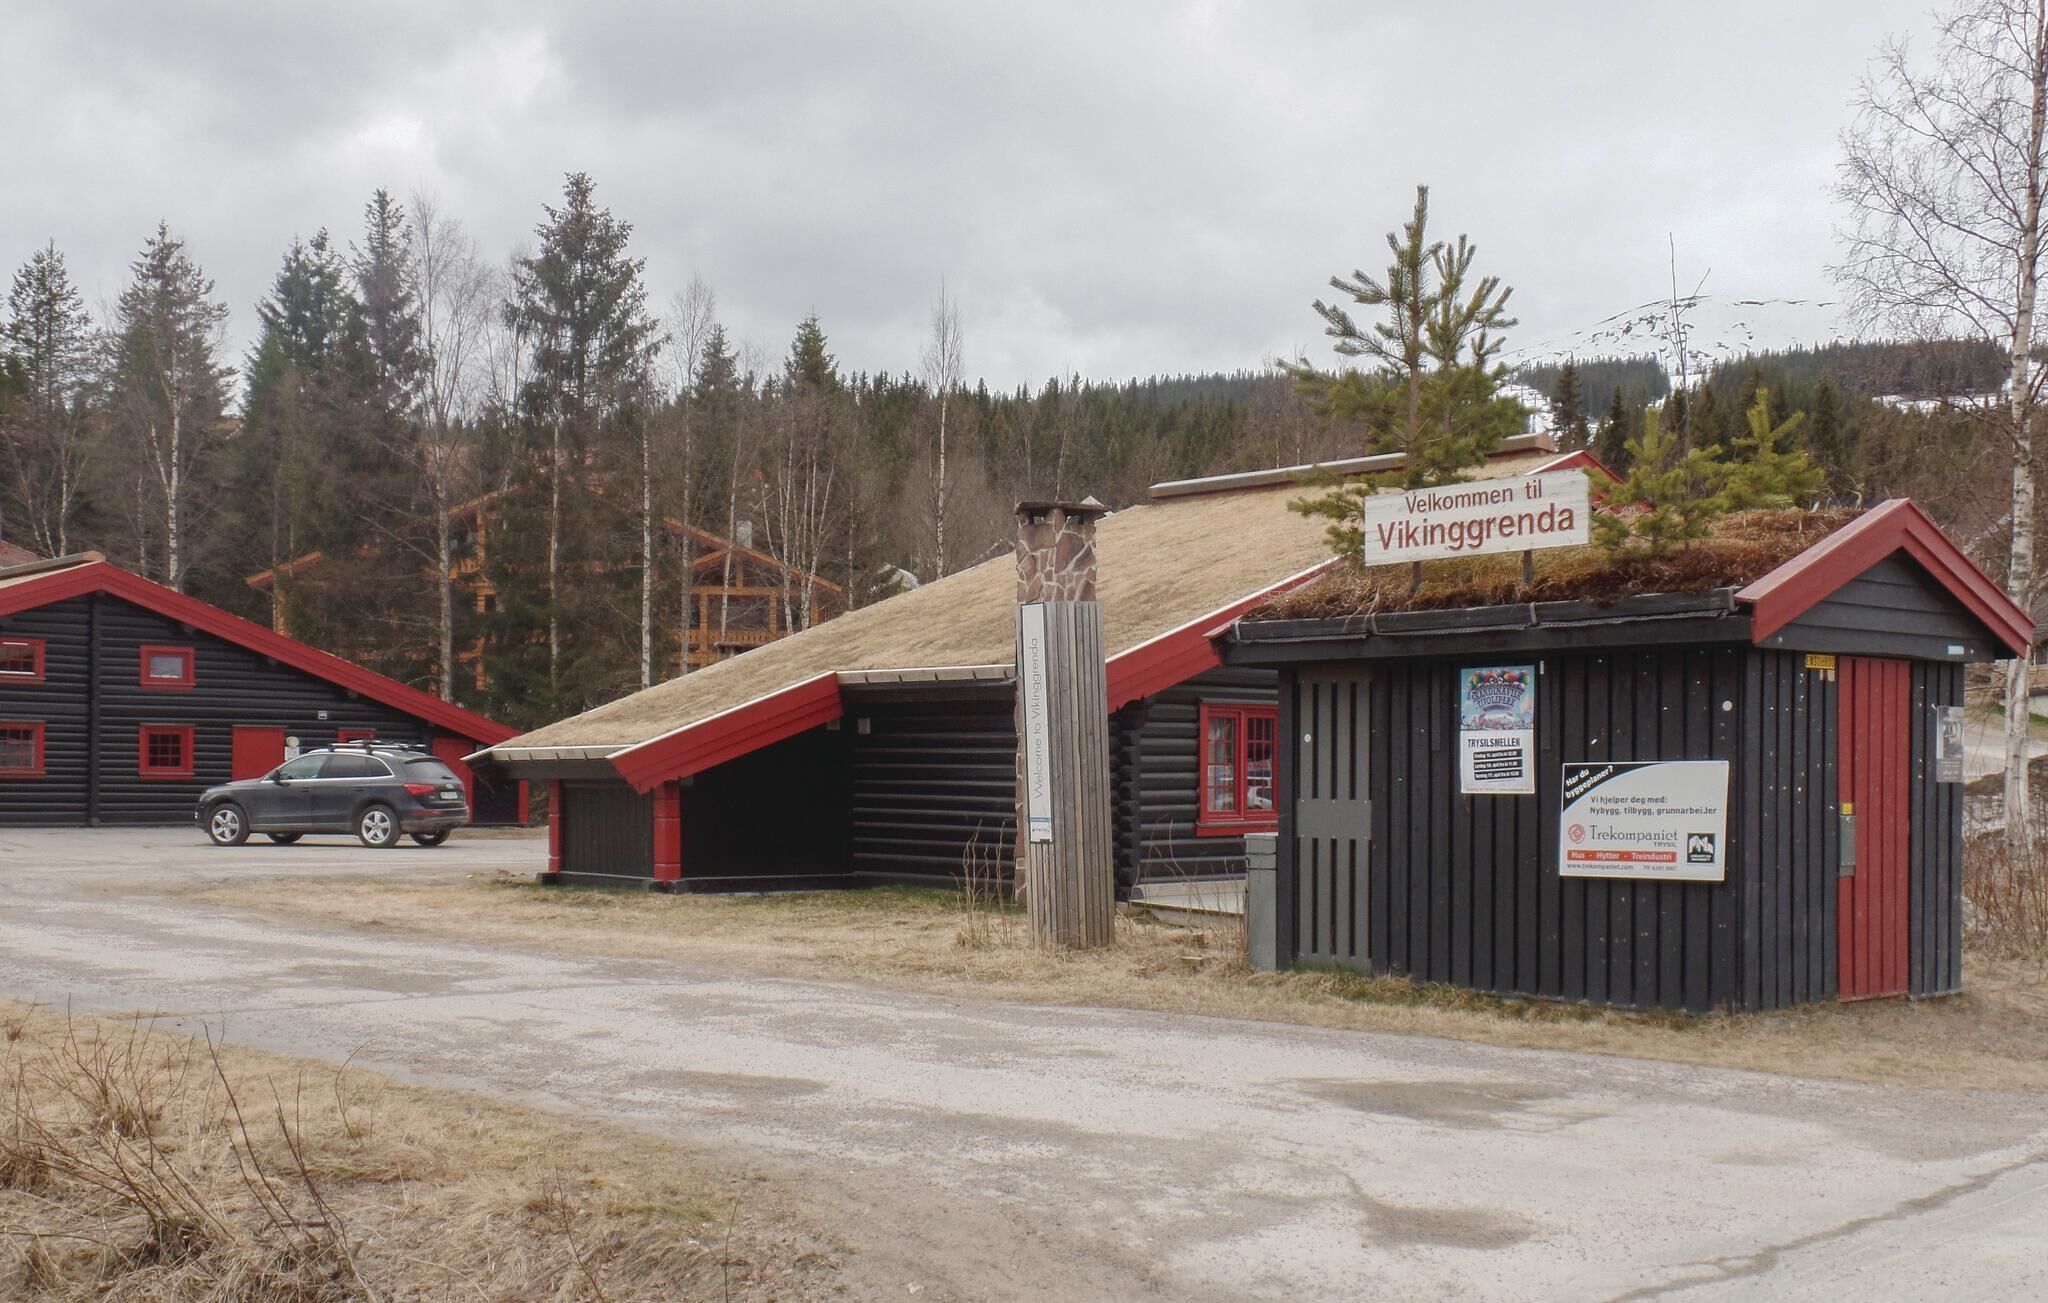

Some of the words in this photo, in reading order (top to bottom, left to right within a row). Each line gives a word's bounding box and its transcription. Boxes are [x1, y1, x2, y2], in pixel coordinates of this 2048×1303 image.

[1405, 487, 1513, 514] Velkommen
[1525, 479, 1542, 500] til
[1377, 502, 1575, 550] Vikinggrenda
[1031, 637, 1043, 720] Vikinggrenda
[1033, 722, 1042, 735] to
[1467, 738, 1520, 748] TRYSILSMELLEN
[1033, 738, 1044, 799] Welcome
[1566, 775, 1579, 787] Har
[1580, 769, 1590, 778] du
[1565, 764, 1614, 799] byggeplaner?
[1600, 796, 1628, 805] hjelper
[1630, 796, 1646, 805] deg
[1648, 796, 1668, 804] med:
[1590, 806, 1621, 816] Nybygg,
[1624, 806, 1654, 816] tilbygg,
[1590, 824, 1678, 844] Trekompaniet
[1572, 851, 1585, 859] Hus
[1596, 852, 1620, 860] Hytter
[1632, 852, 1672, 861] Treindustri
